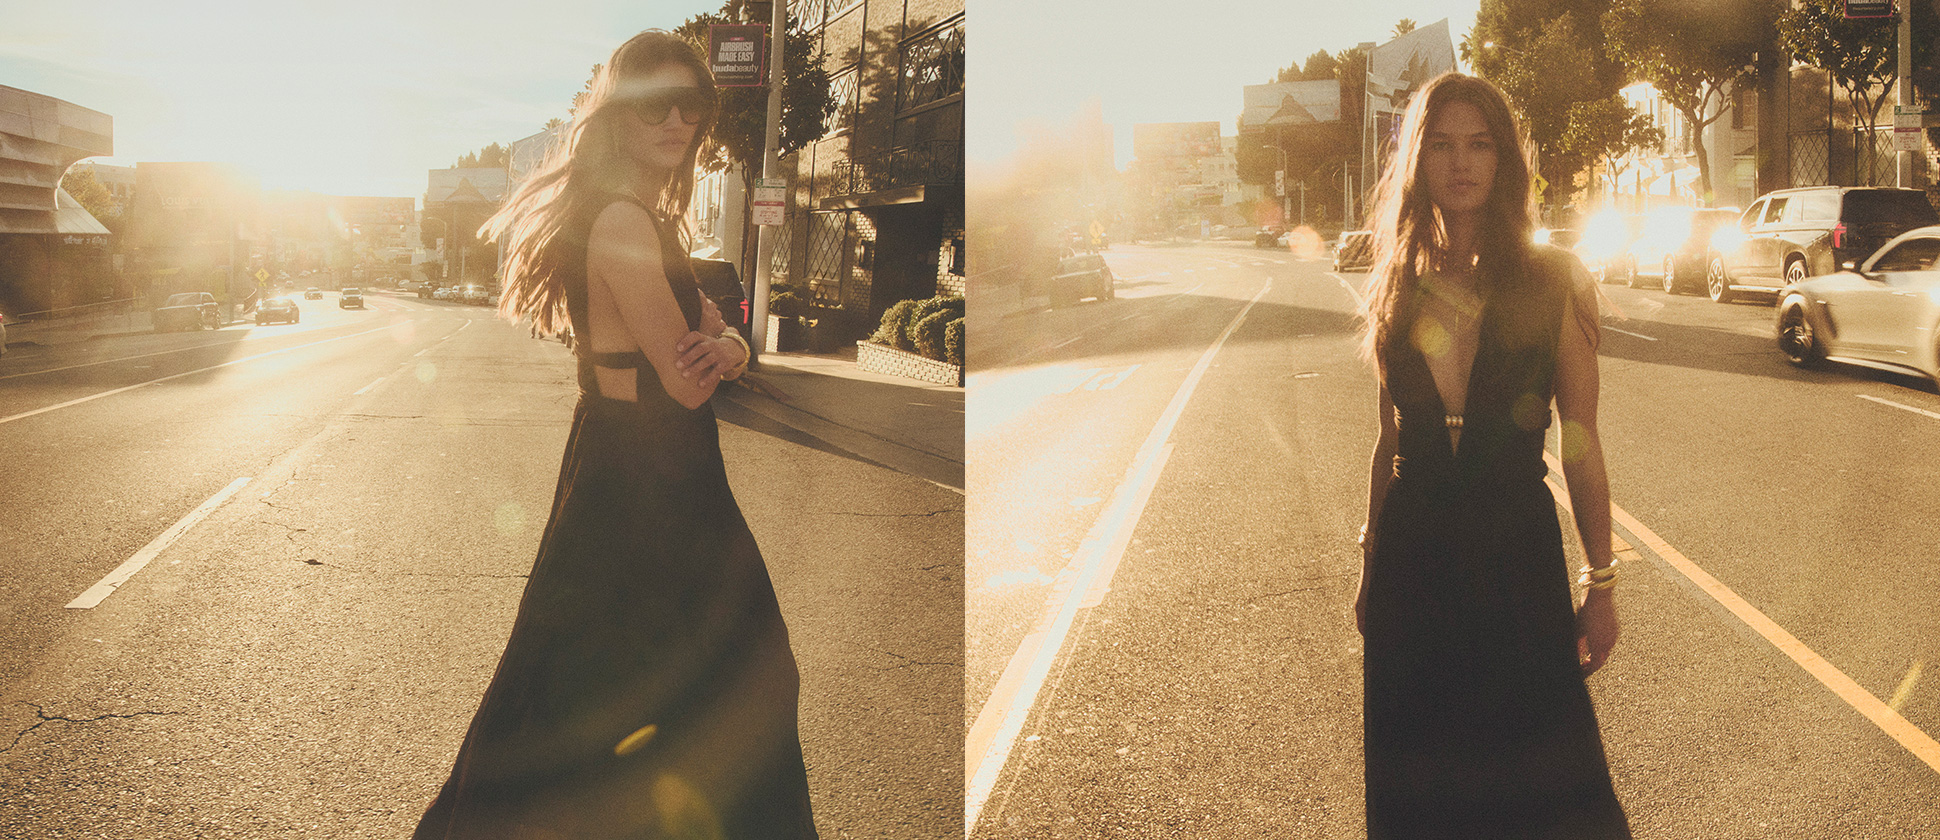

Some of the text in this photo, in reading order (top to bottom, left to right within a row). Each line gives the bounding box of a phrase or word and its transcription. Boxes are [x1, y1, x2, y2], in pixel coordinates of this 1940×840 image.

[720, 42, 754, 52] AIRBRUSH
[718, 52, 755, 61] MADE EASY
[712, 64, 759, 73] hudabeauty
[161, 196, 190, 206] LOUIS
